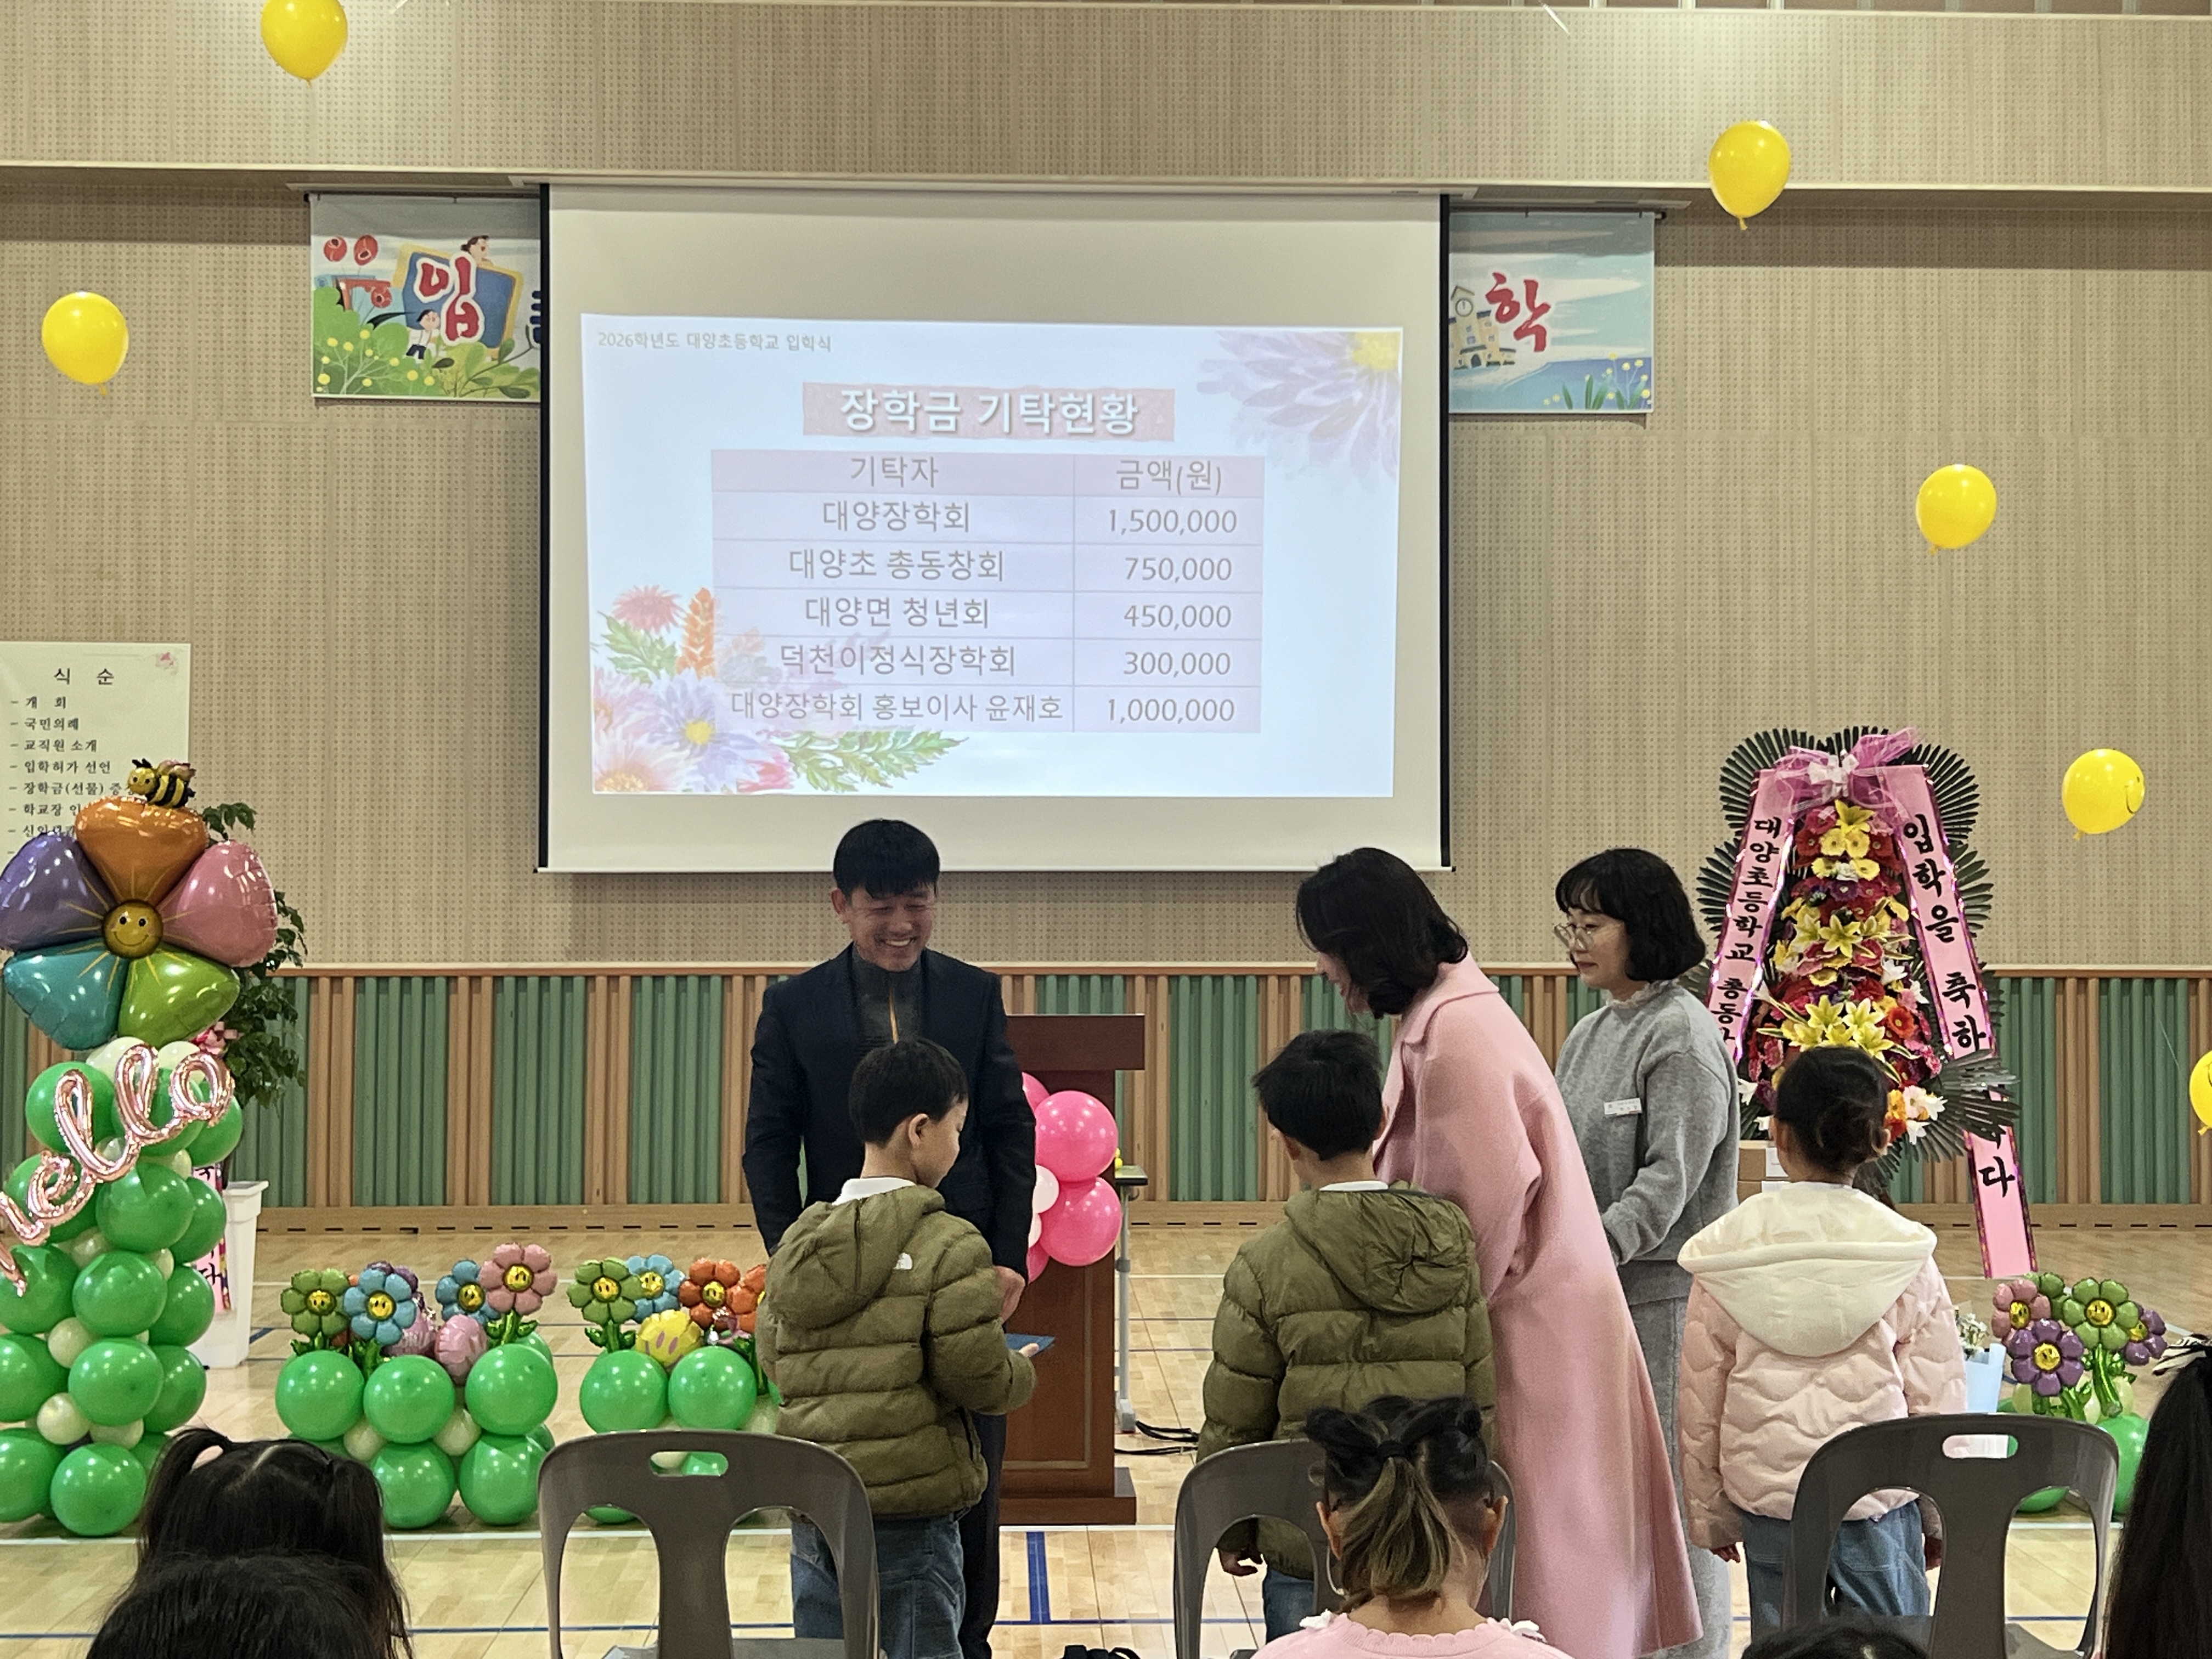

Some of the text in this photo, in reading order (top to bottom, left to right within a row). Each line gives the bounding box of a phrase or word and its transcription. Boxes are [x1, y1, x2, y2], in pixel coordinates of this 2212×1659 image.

[416, 253, 483, 344] 입
[1485, 272, 1552, 353] 학
[598, 331, 832, 352] 2026학년도 대양초등학교 입학식
[839, 388, 1139, 436] 장학금 기탁현황
[850, 455, 939, 488] 기탁자
[1116, 460, 1222, 496] 금액(원)
[822, 500, 970, 533] 대양장학회
[1109, 509, 1238, 535] 1,500,000
[789, 549, 1004, 582] 대양초 총동창회
[1124, 557, 1232, 583] 750,000
[805, 596, 989, 629] 대양면 청년회
[1124, 605, 1232, 631] 450,000
[780, 644, 1015, 676] 덕천이정식장학회
[1123, 651, 1231, 678] 300,000
[731, 692, 1063, 723] 대양장학회 홍보이사 윤재호
[1108, 698, 1235, 725] 1,000,000
[24, 717, 80, 731] 국민의례
[24, 738, 98, 753] 교직원 소개
[24, 760, 110, 774] 입학허가 선언
[1724, 816, 1782, 962] 대양초등학교
[1903, 813, 1959, 944] 입학을
